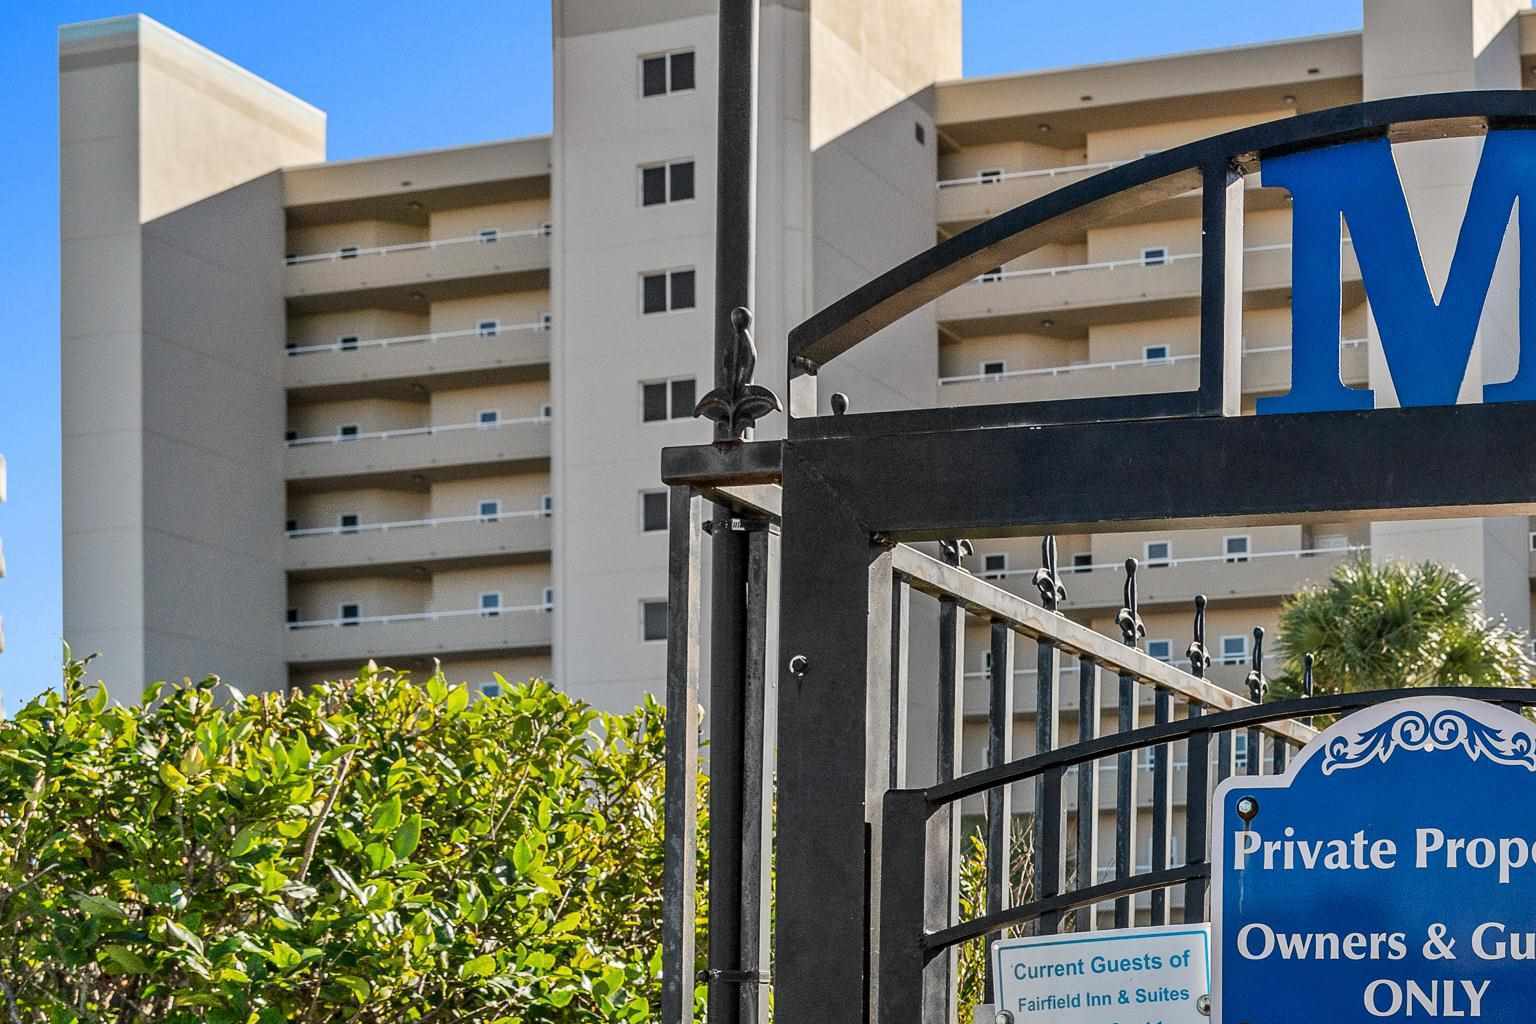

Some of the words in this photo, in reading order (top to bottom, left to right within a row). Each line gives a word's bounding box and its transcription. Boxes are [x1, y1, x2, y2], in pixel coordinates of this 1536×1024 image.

[1232, 826, 1397, 870] Private
[1236, 922, 1407, 960] Owners
[1422, 922, 1456, 960] &
[1014, 958, 1085, 981] Current
[1090, 954, 1163, 974] Guests
[1169, 949, 1191, 968] of
[1018, 992, 1081, 1012] Fairfield
[1086, 991, 1112, 1007] Inn
[1118, 989, 1130, 1004] &
[1135, 986, 1190, 1003] Suites
[1363, 979, 1492, 1017] ONLY
